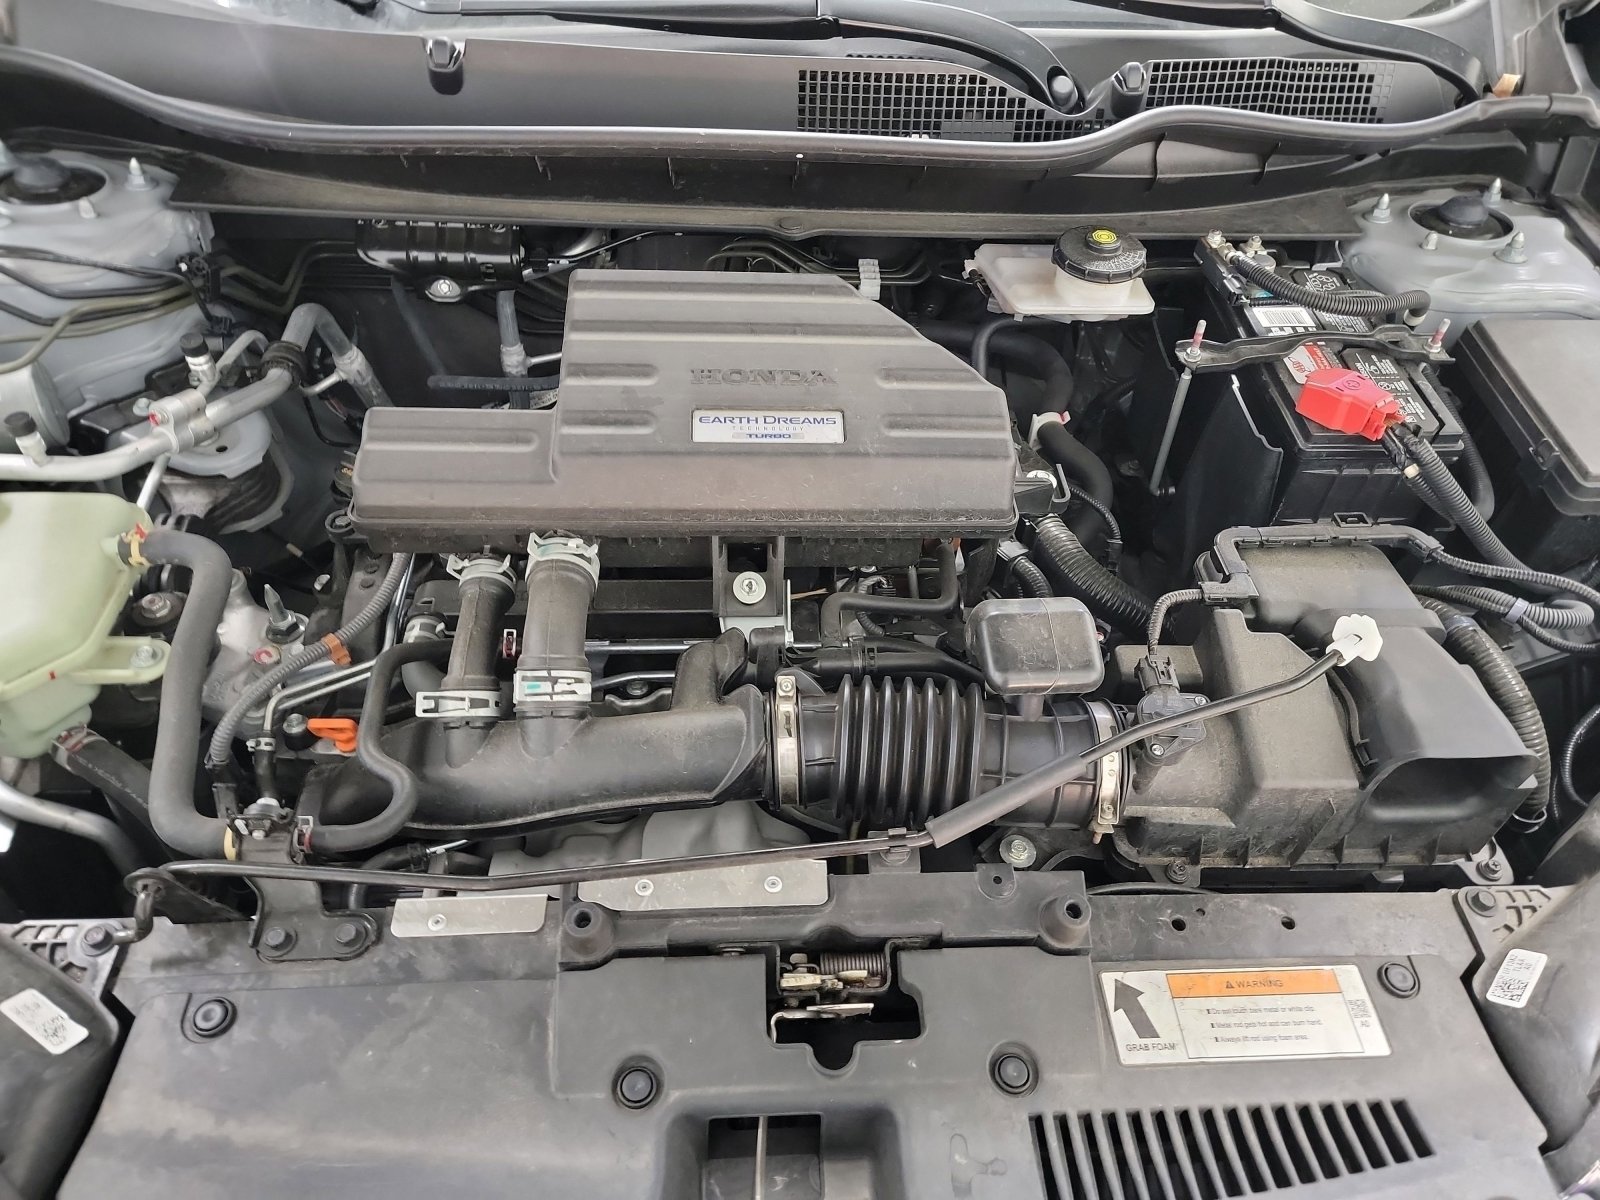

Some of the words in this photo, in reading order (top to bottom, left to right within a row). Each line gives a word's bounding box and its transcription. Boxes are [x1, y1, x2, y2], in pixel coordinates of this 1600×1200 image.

[690, 368, 838, 386] HONDA
[699, 415, 759, 425] EARTH
[763, 415, 837, 425] DREAMS
[1235, 979, 1283, 988] WARNING
[1126, 1043, 1150, 1052] GRAB
[1151, 1042, 1175, 1051] FOAM
